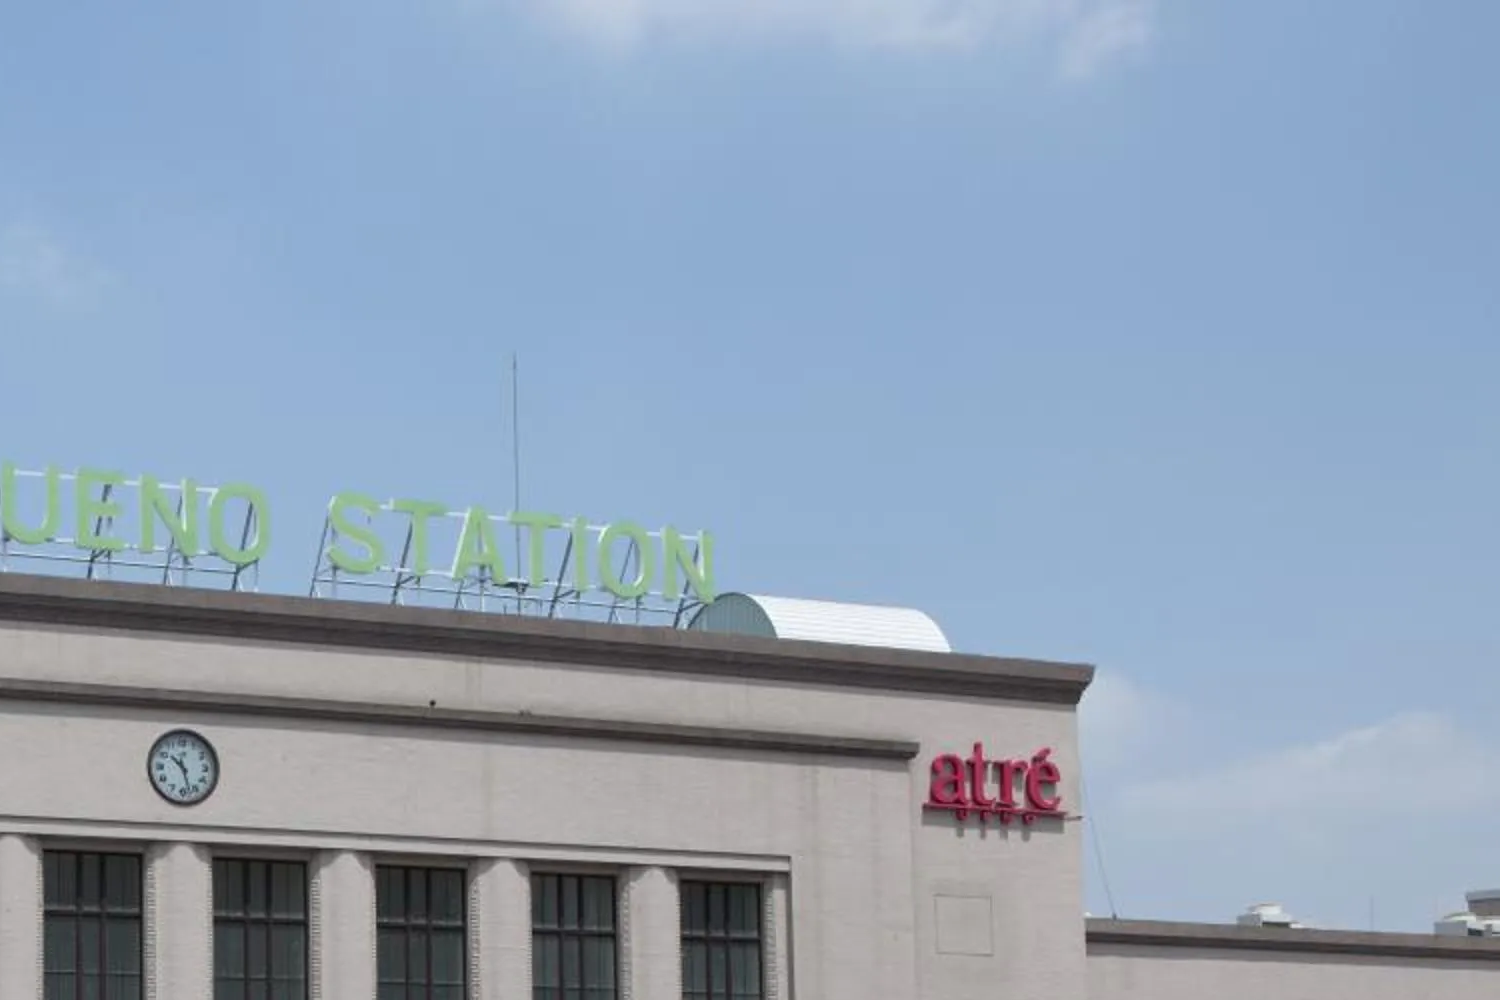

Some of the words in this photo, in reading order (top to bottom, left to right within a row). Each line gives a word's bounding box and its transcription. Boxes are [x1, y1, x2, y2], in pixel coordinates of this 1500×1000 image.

[0, 459, 272, 565] UENO
[324, 492, 716, 604] STATION
[929, 742, 1061, 811] atré
